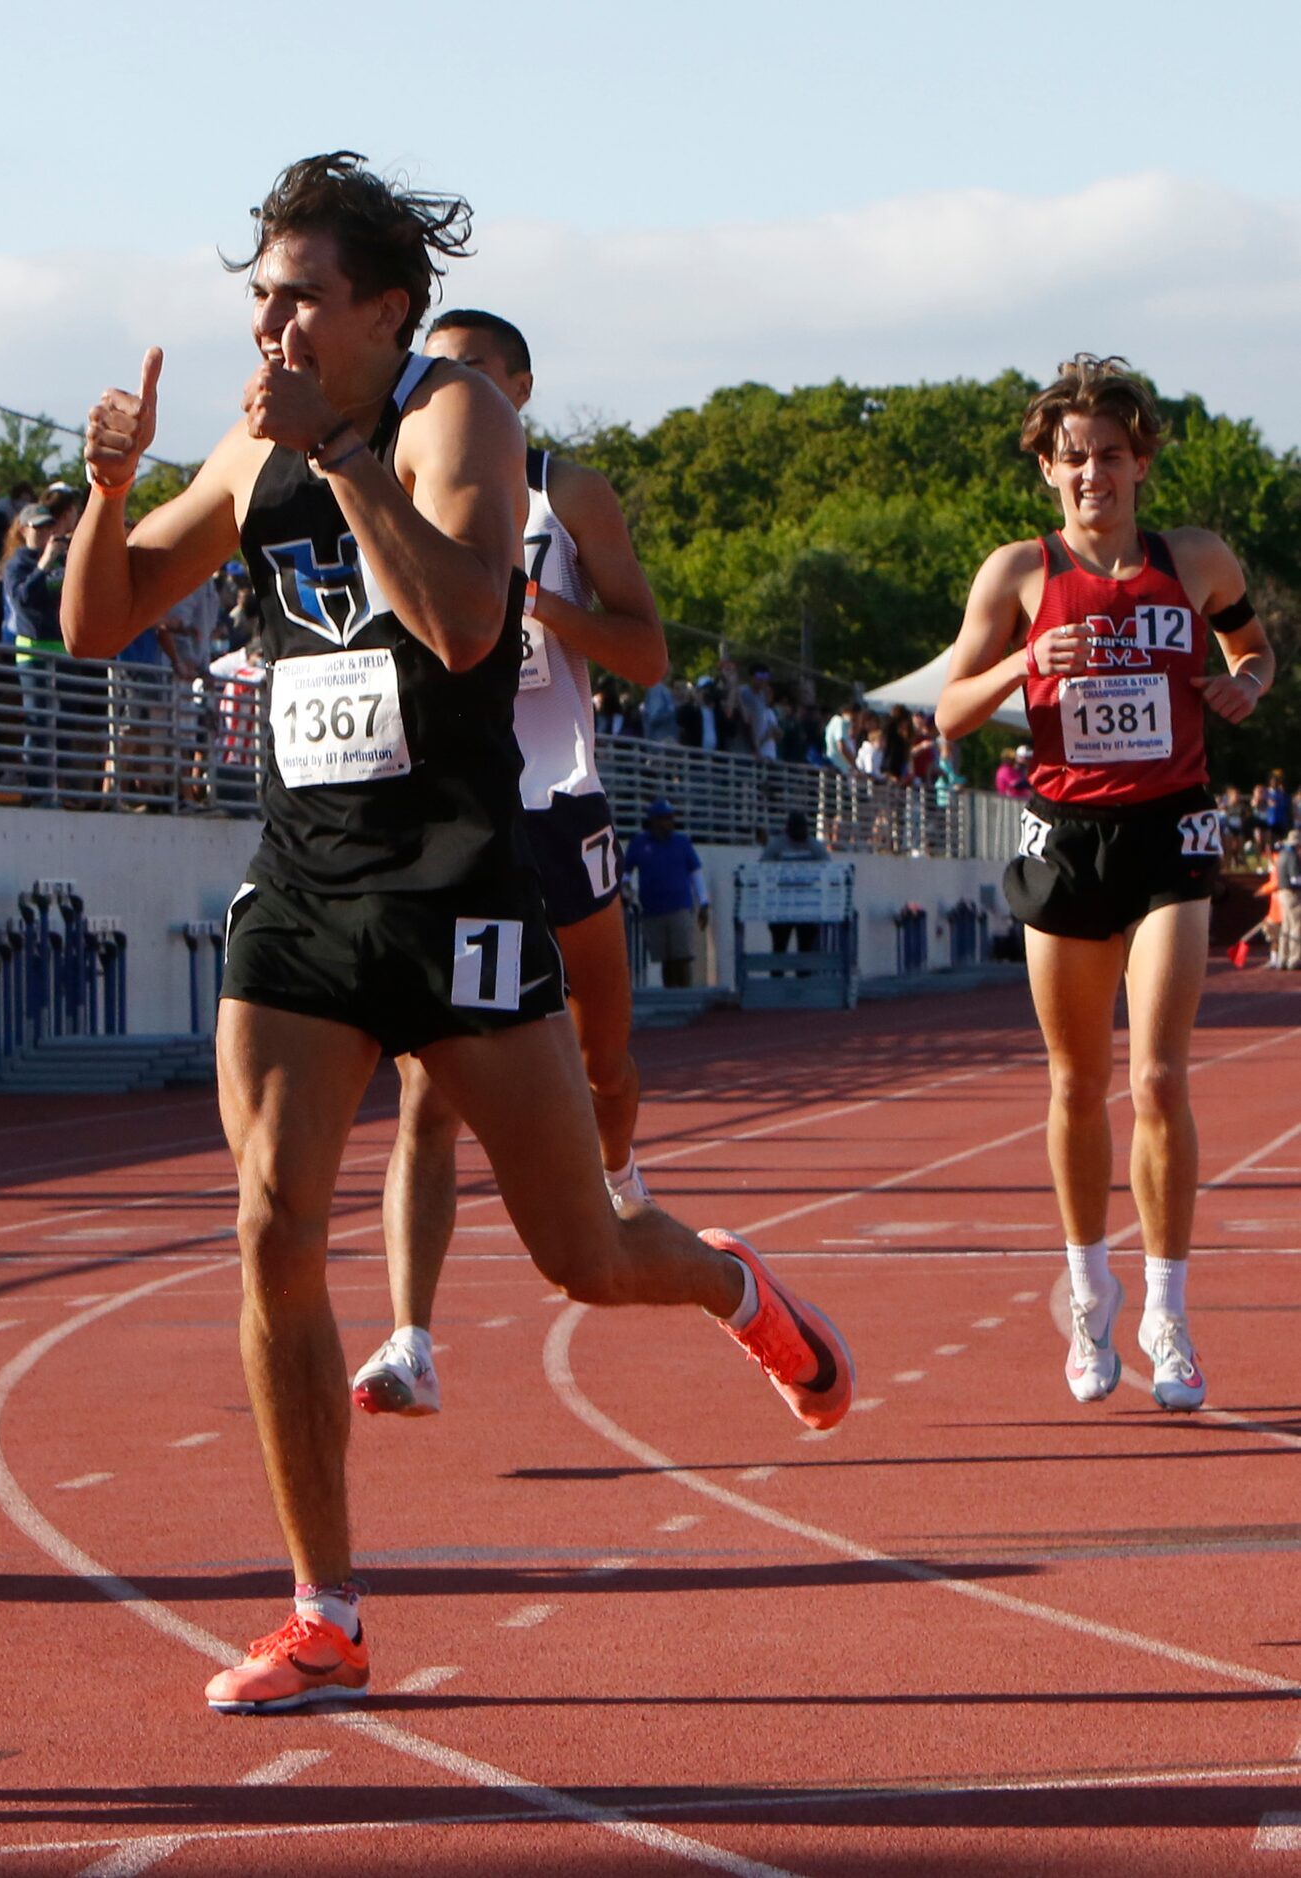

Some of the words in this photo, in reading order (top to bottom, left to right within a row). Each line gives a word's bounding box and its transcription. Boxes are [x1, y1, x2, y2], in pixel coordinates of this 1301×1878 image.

[524, 534, 552, 582] 7
[1140, 607, 1185, 648] 12
[359, 655, 383, 668] FIELD
[294, 672, 367, 690] CHAMPIONSHIPS
[1083, 688, 1146, 699] CHAMPIONSHIPS
[1104, 679, 1128, 688] TRACK
[1139, 677, 1158, 686] FIELD
[283, 693, 383, 744] 1367
[1073, 701, 1156, 736] 1381
[283, 755, 309, 768] Hosted
[311, 754, 322, 767] by
[1074, 741, 1101, 751] Hosted
[1102, 741, 1112, 751] by
[1020, 813, 1042, 857] 12
[1180, 813, 1221, 852] 12
[585, 833, 611, 890] 7
[466, 924, 500, 1001] 1
